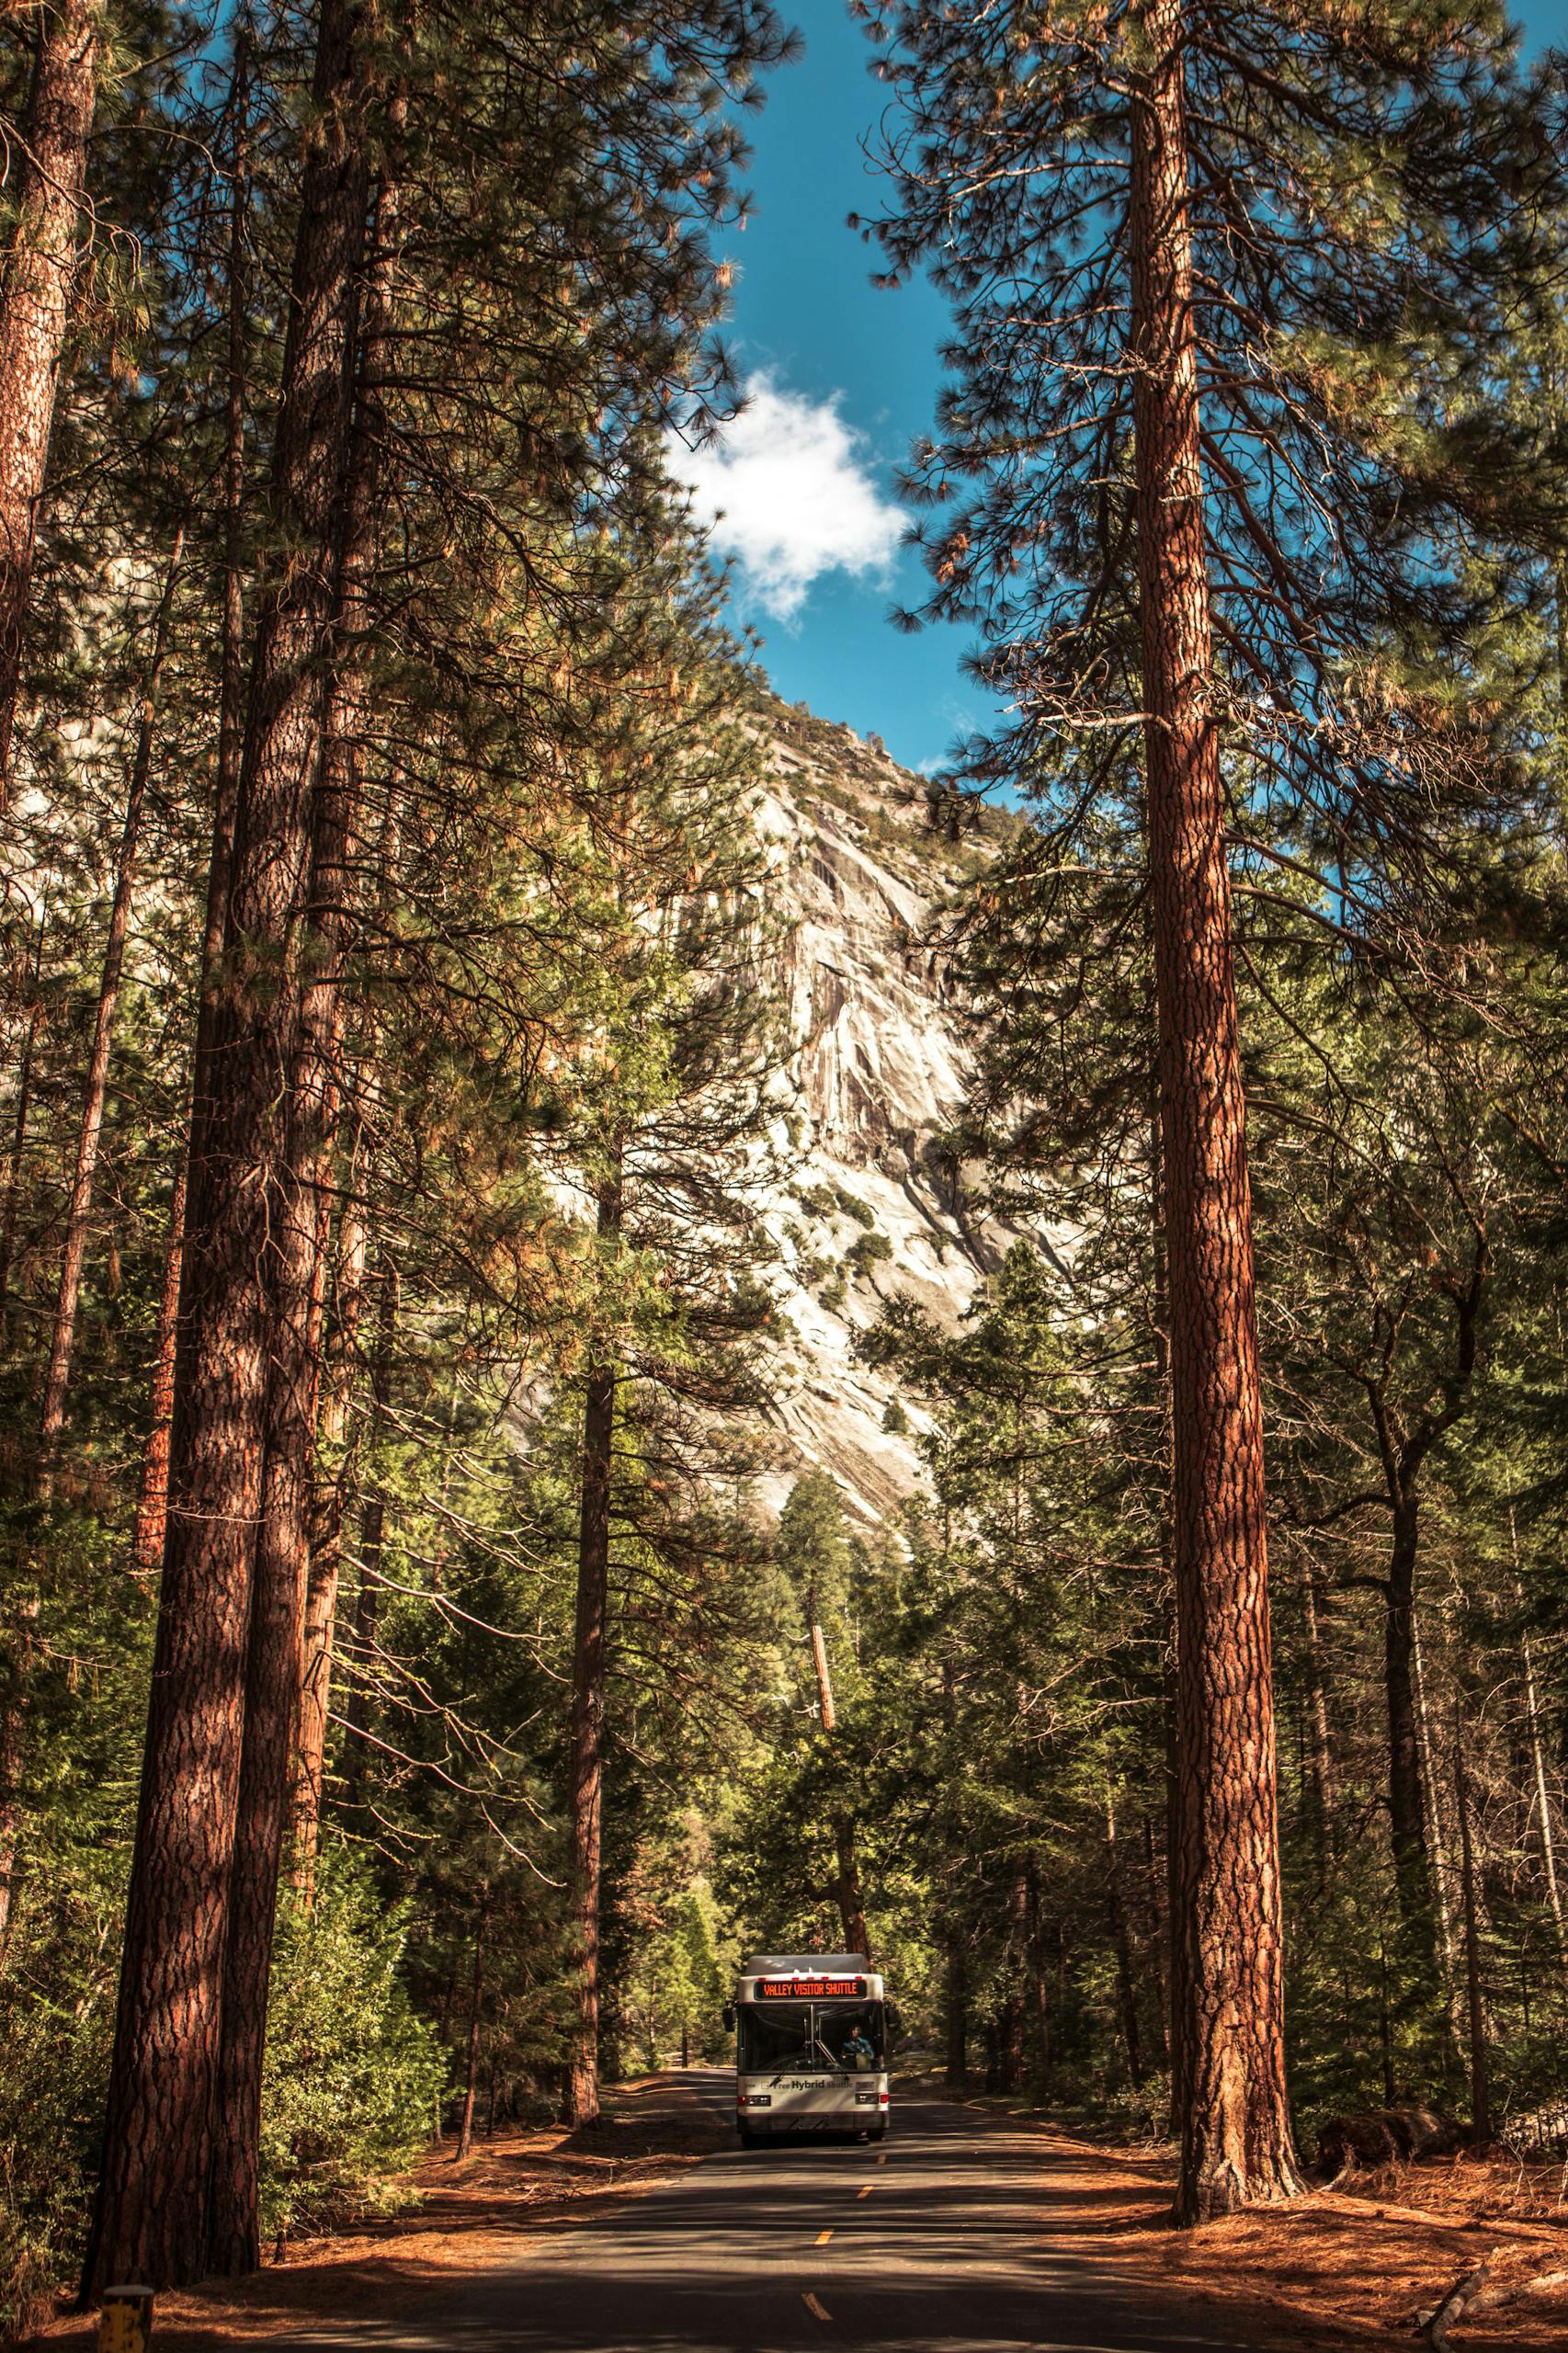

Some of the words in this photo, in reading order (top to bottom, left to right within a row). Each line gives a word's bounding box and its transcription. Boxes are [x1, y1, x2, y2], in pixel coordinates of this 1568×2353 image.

[764, 1984, 792, 1995] VALLEY
[794, 1984, 824, 1995] VISITOR
[825, 1983, 858, 1995] SHUTTLE
[791, 2080, 824, 2091] Hybrid
